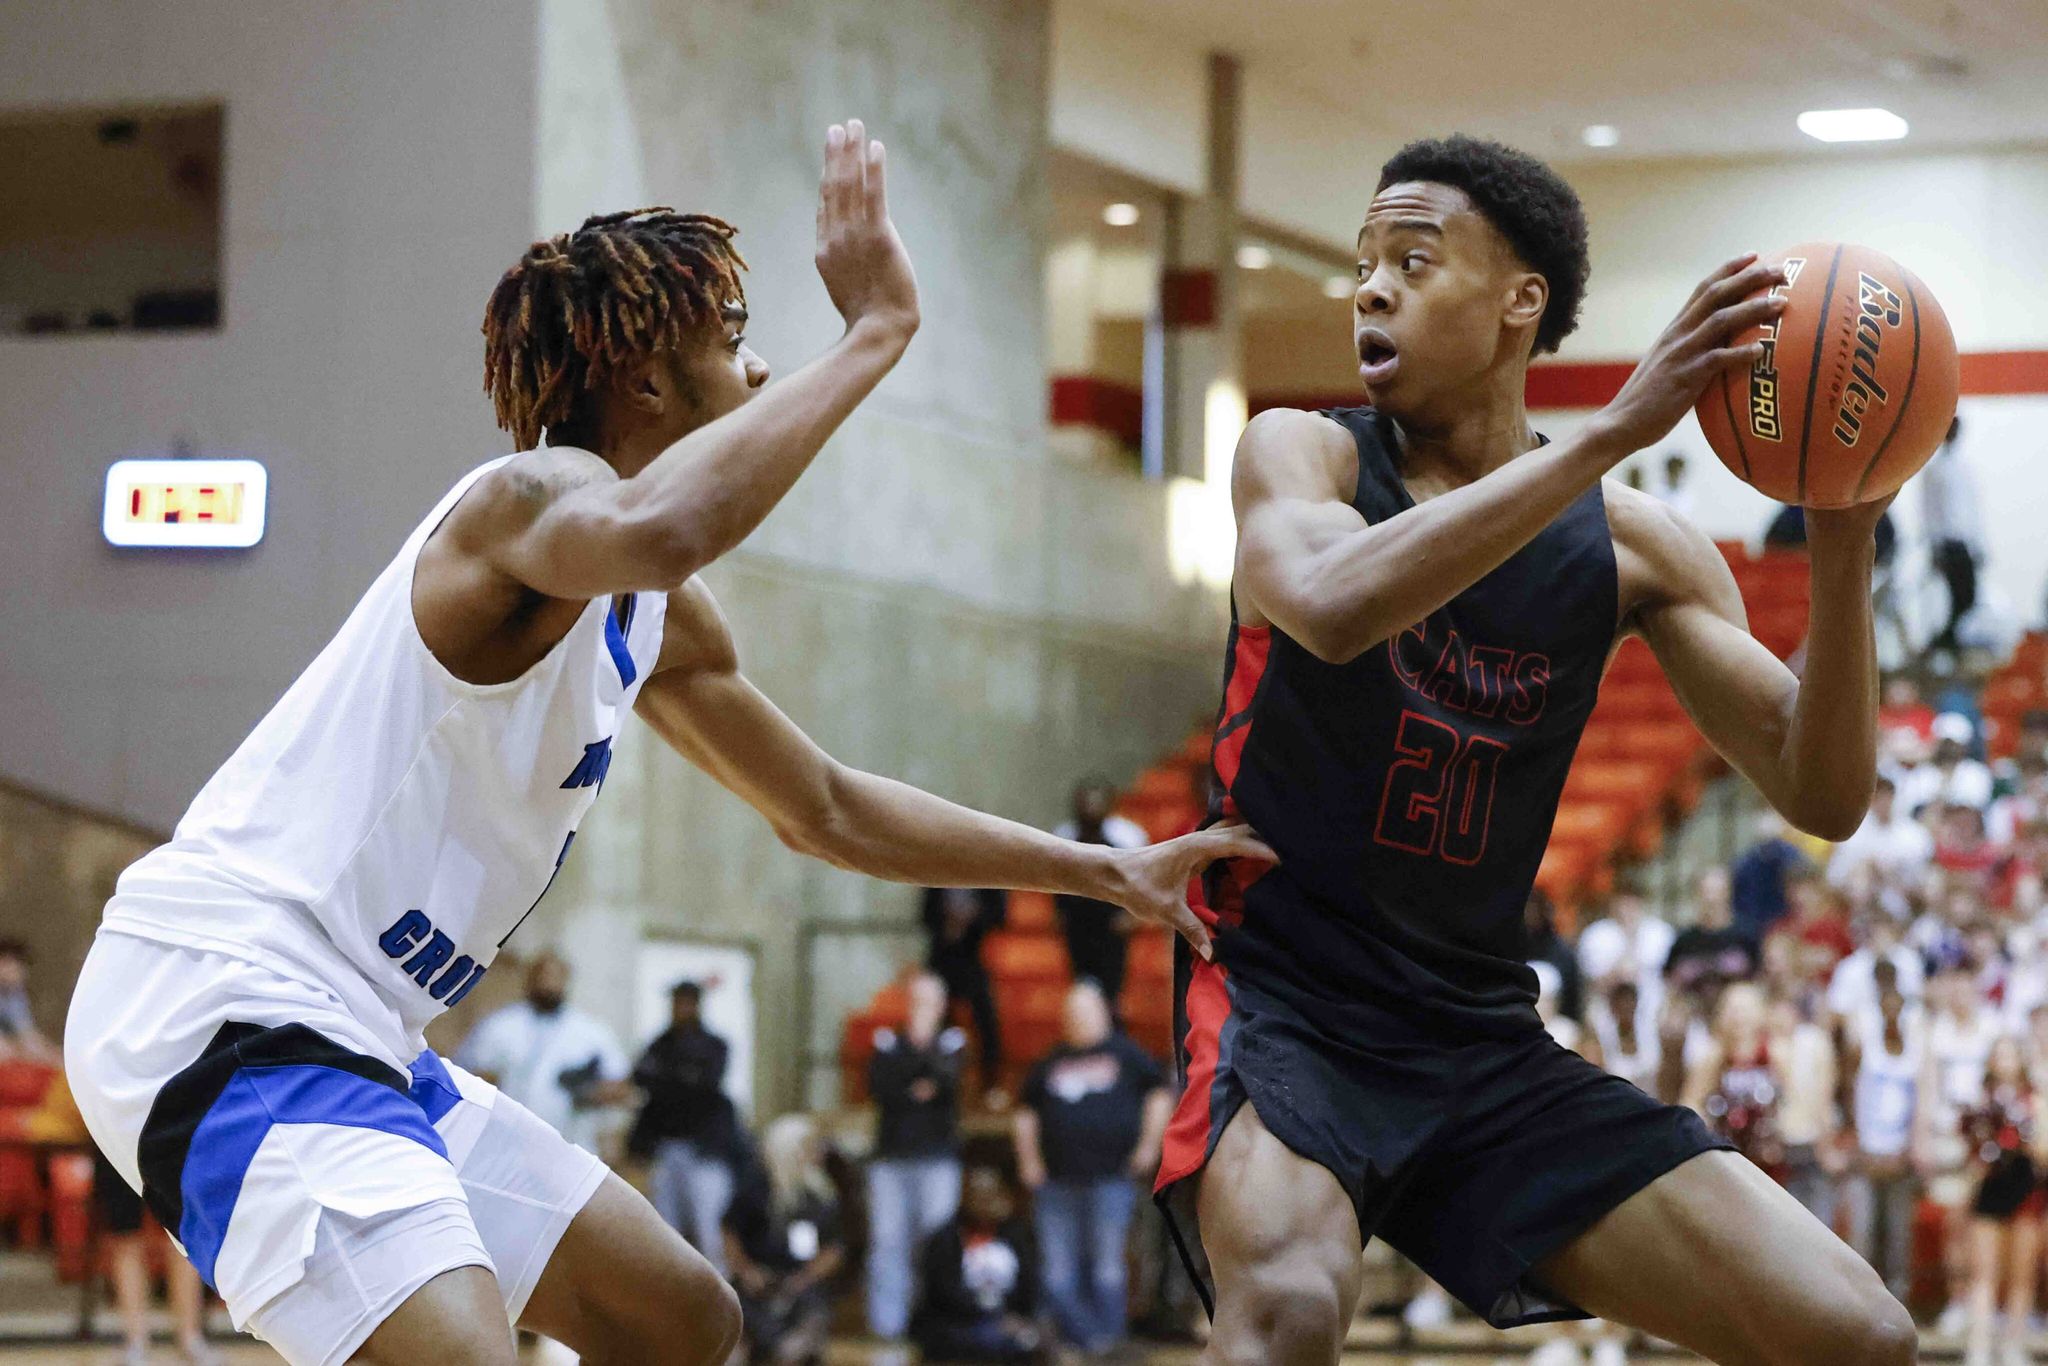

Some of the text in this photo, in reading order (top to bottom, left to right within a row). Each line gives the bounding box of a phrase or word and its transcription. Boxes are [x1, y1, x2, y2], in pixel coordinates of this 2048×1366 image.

[1752, 376, 1778, 439] PRO
[1832, 271, 1903, 447] Baden
[1388, 620, 1551, 725] CATS
[1373, 709, 1511, 865] 20
